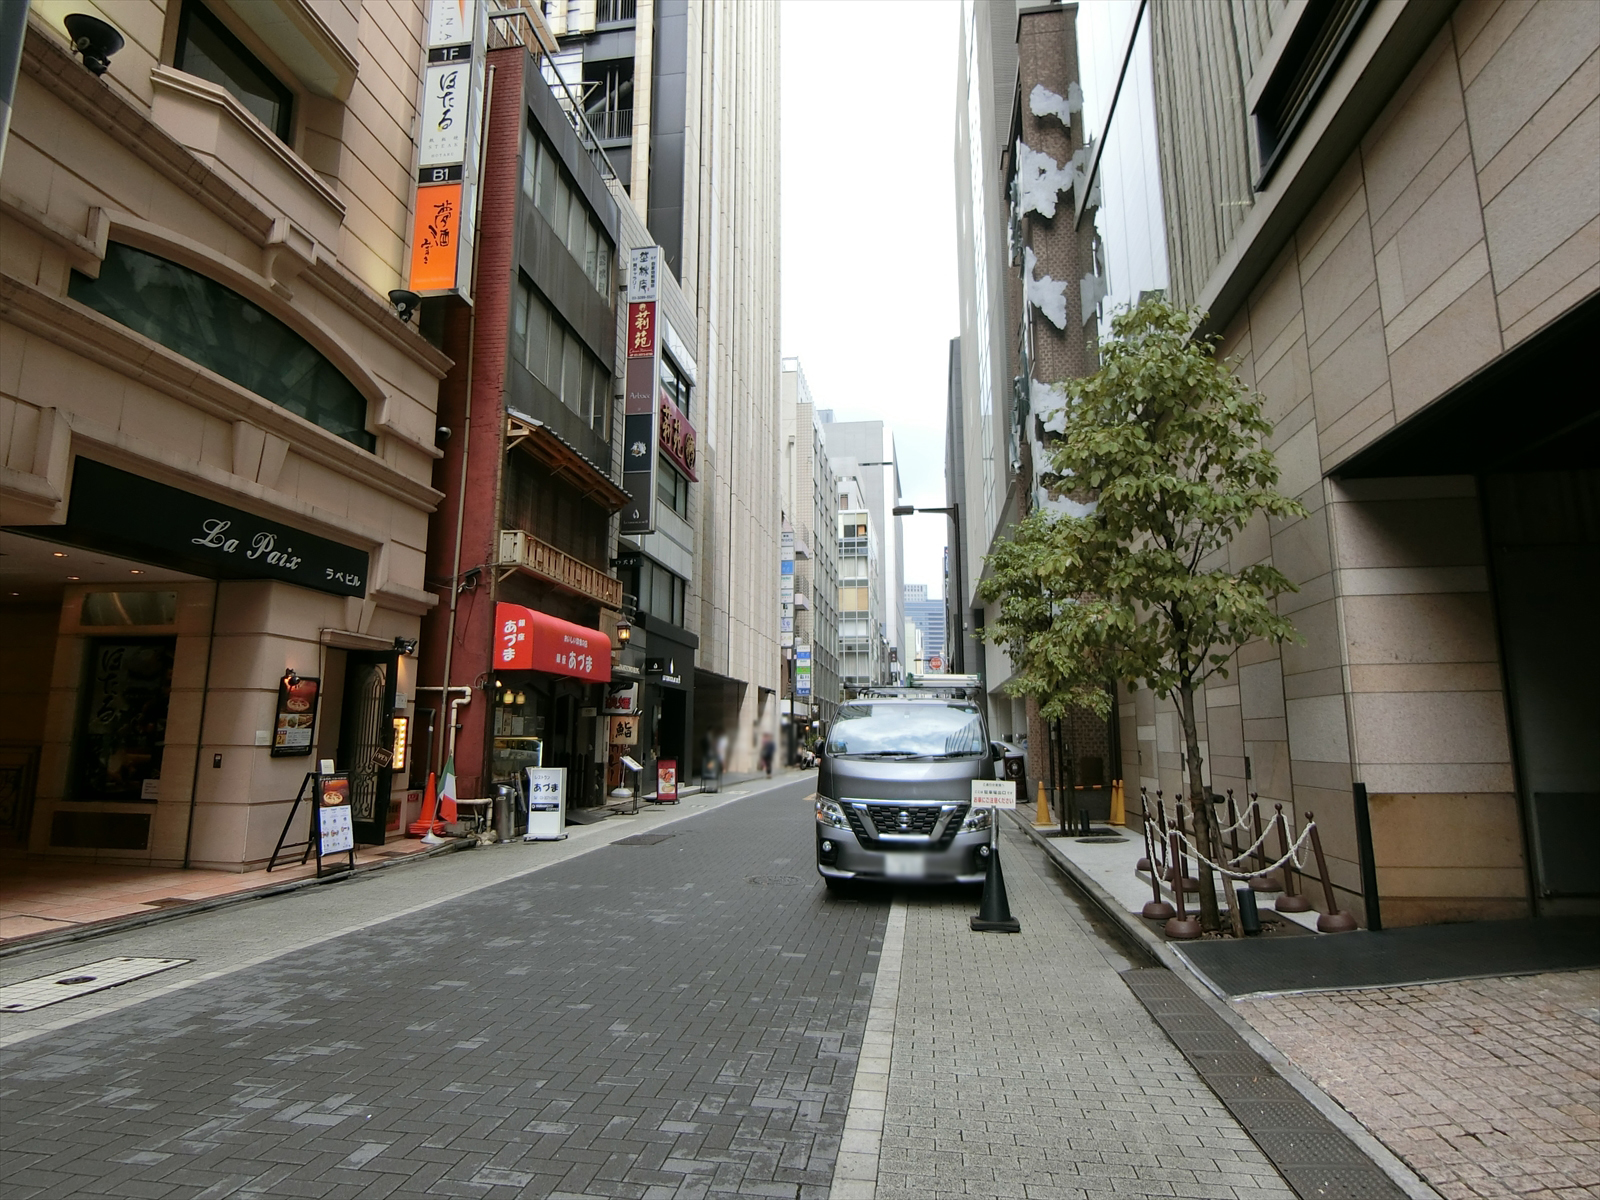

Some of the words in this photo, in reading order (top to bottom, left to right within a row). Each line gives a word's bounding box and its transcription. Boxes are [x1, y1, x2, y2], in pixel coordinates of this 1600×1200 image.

[442, 48, 459, 61] 1F
[437, 71, 458, 130] ほたる
[428, 142, 458, 150] STEAK
[433, 168, 449, 181] B1
[191, 518, 240, 553] La
[247, 532, 302, 570] Paix
[517, 619, 526, 641] 銀座
[502, 619, 517, 662] あづま
[568, 651, 593, 673] あづま
[615, 721, 632, 738] 鮨
[374, 751, 389, 762] OPEN
[533, 783, 559, 793] あづま
